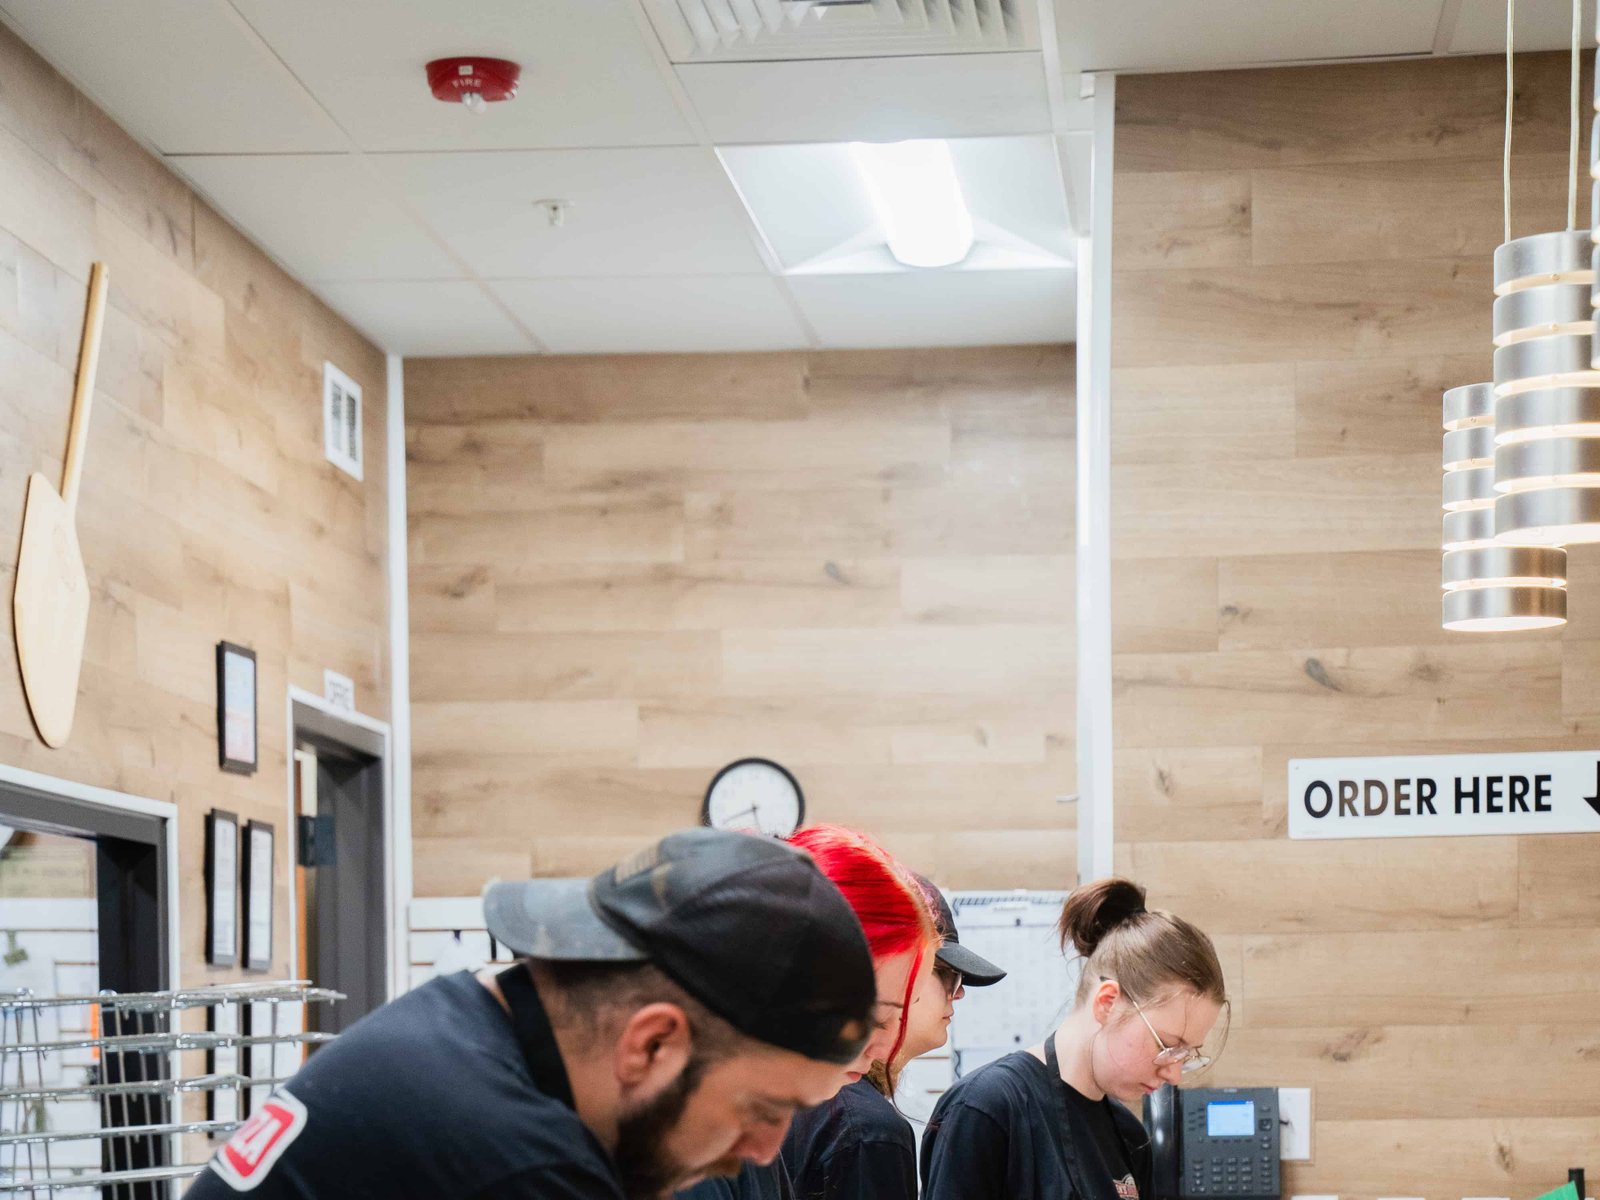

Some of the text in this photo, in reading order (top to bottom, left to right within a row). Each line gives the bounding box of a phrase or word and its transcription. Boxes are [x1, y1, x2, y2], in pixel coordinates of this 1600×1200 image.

[451, 78, 482, 89] FIRE
[1304, 774, 1552, 818] ORDER HERE
